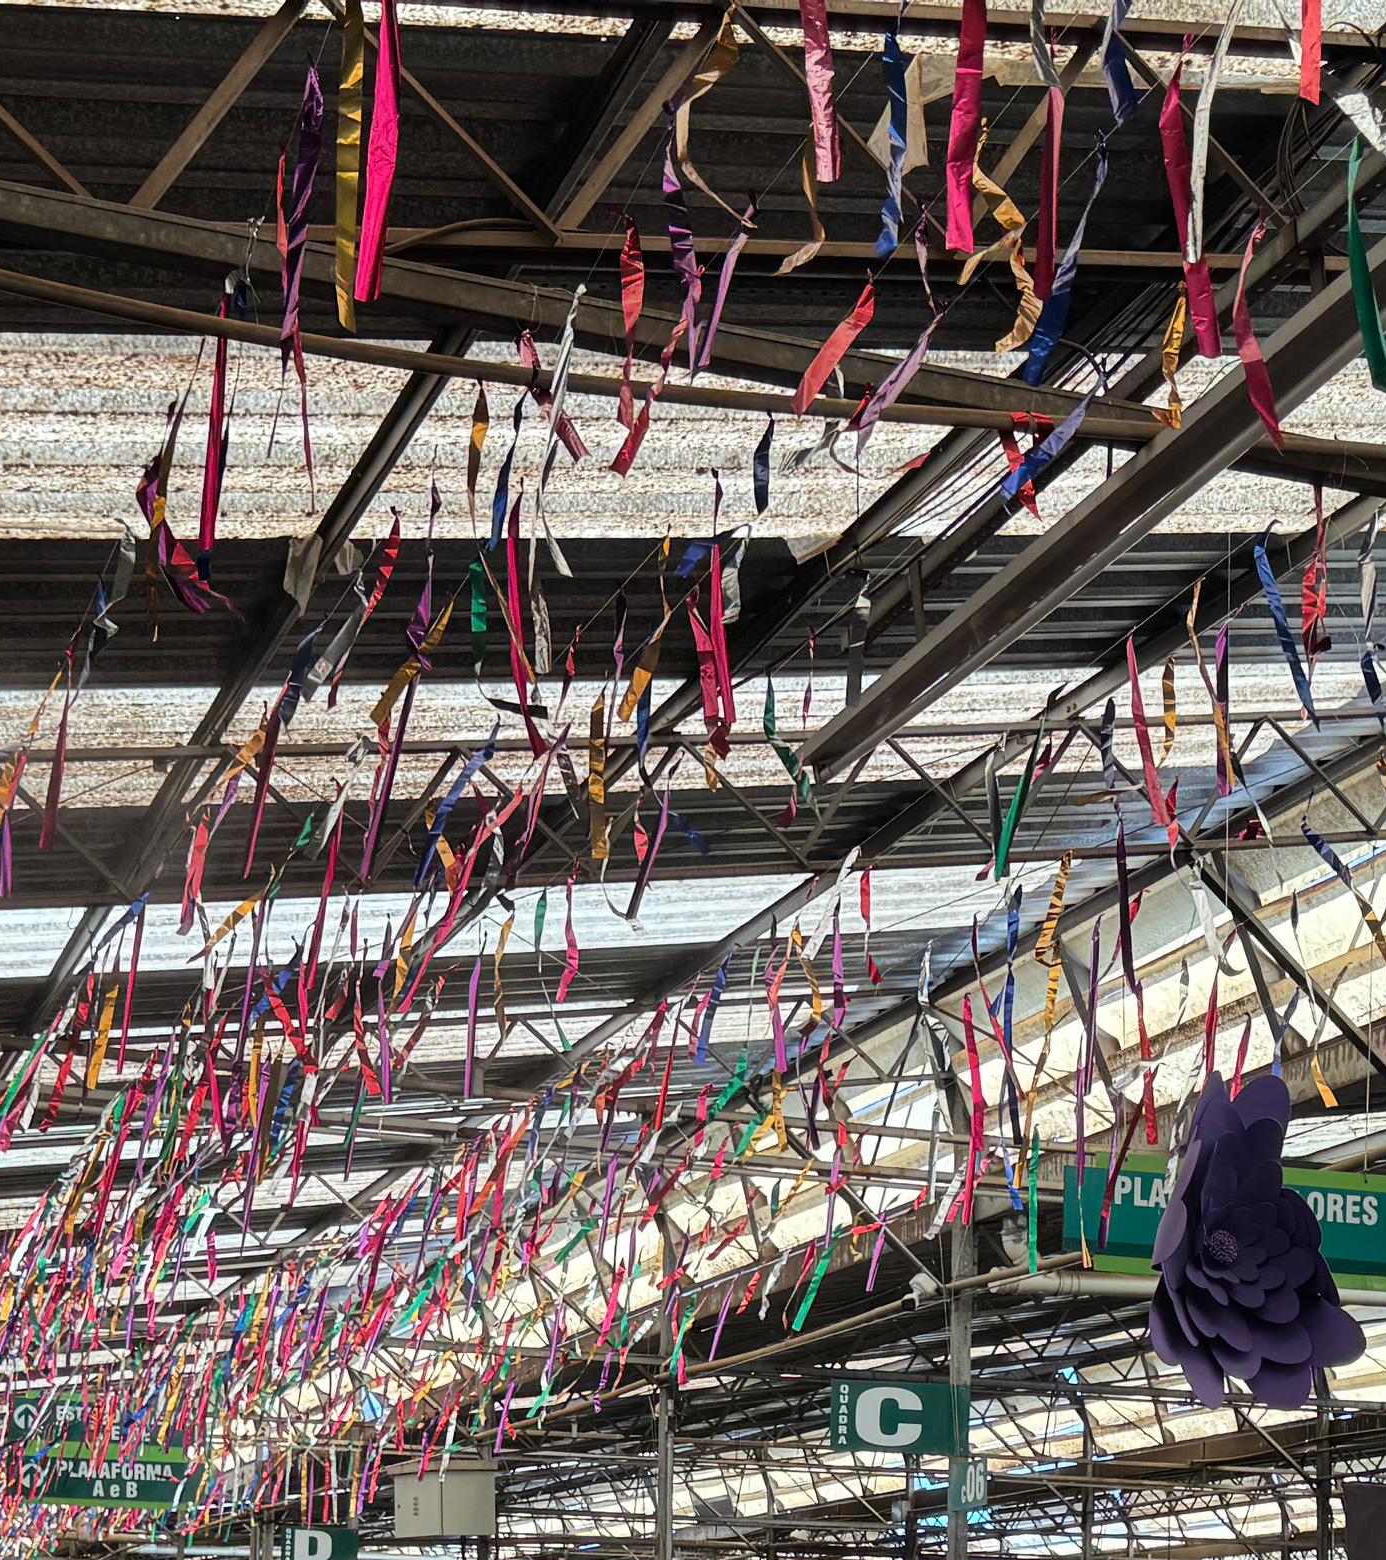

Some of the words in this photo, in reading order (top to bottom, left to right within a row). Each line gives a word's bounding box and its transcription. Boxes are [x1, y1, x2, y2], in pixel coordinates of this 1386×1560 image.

[1306, 1190, 1379, 1226] ORES
[837, 1384, 850, 1445] QUADRA
[855, 1386, 923, 1447] C
[92, 1479, 105, 1497] A
[109, 1483, 120, 1496] e
[126, 1481, 138, 1499] B
[960, 1462, 985, 1504] C06
